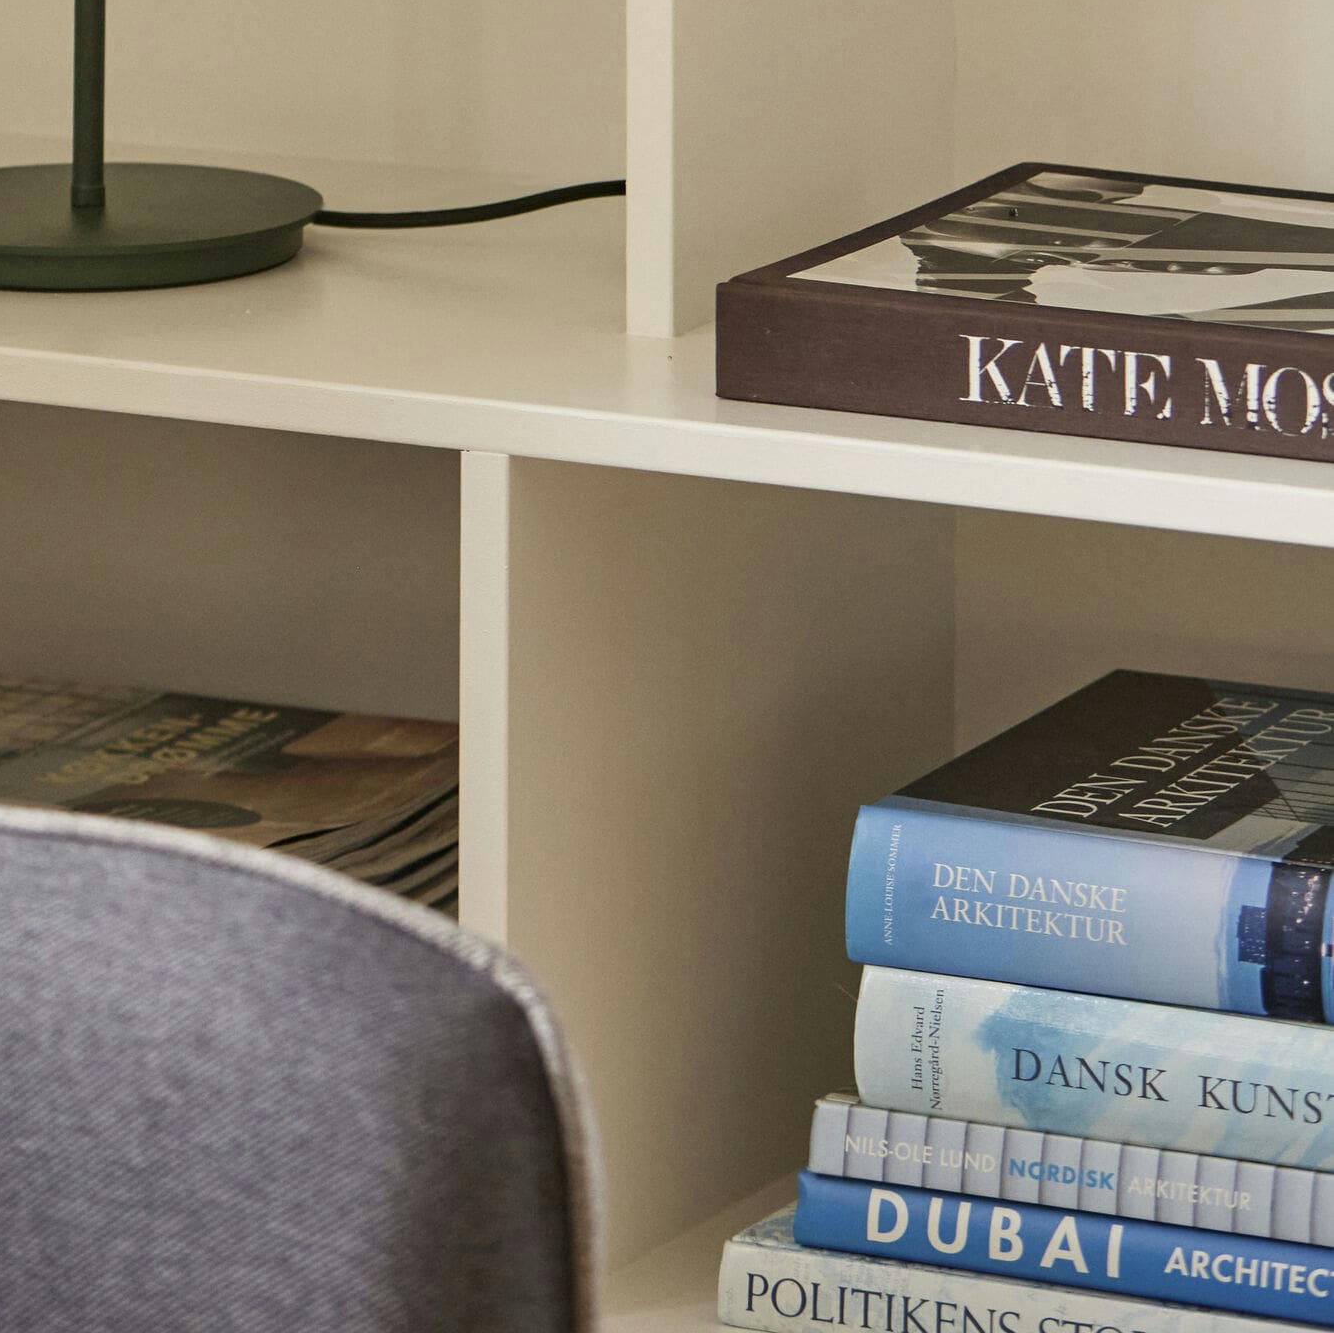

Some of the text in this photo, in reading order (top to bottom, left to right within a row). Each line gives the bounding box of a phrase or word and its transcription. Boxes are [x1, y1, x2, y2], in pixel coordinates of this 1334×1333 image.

[958, 333, 1172, 421] KATE
[1030, 697, 1279, 818] DEN DANSKE
[1118, 708, 1334, 828] ARKITEKTUR
[883, 822, 902, 946] ANNE-LOUISE SOMMER
[930, 895, 1128, 946] ARKITEKTUR
[932, 862, 1128, 914] DEN DANSKE
[911, 1005, 925, 1091] Hans Edvard
[1011, 1047, 1334, 1125] DANSK KUNS
[844, 1133, 1252, 1212] NILS-OLE LUND NORDISK ARKITEKTUR
[866, 1188, 1334, 1298] DUBAI ARCHITEC
